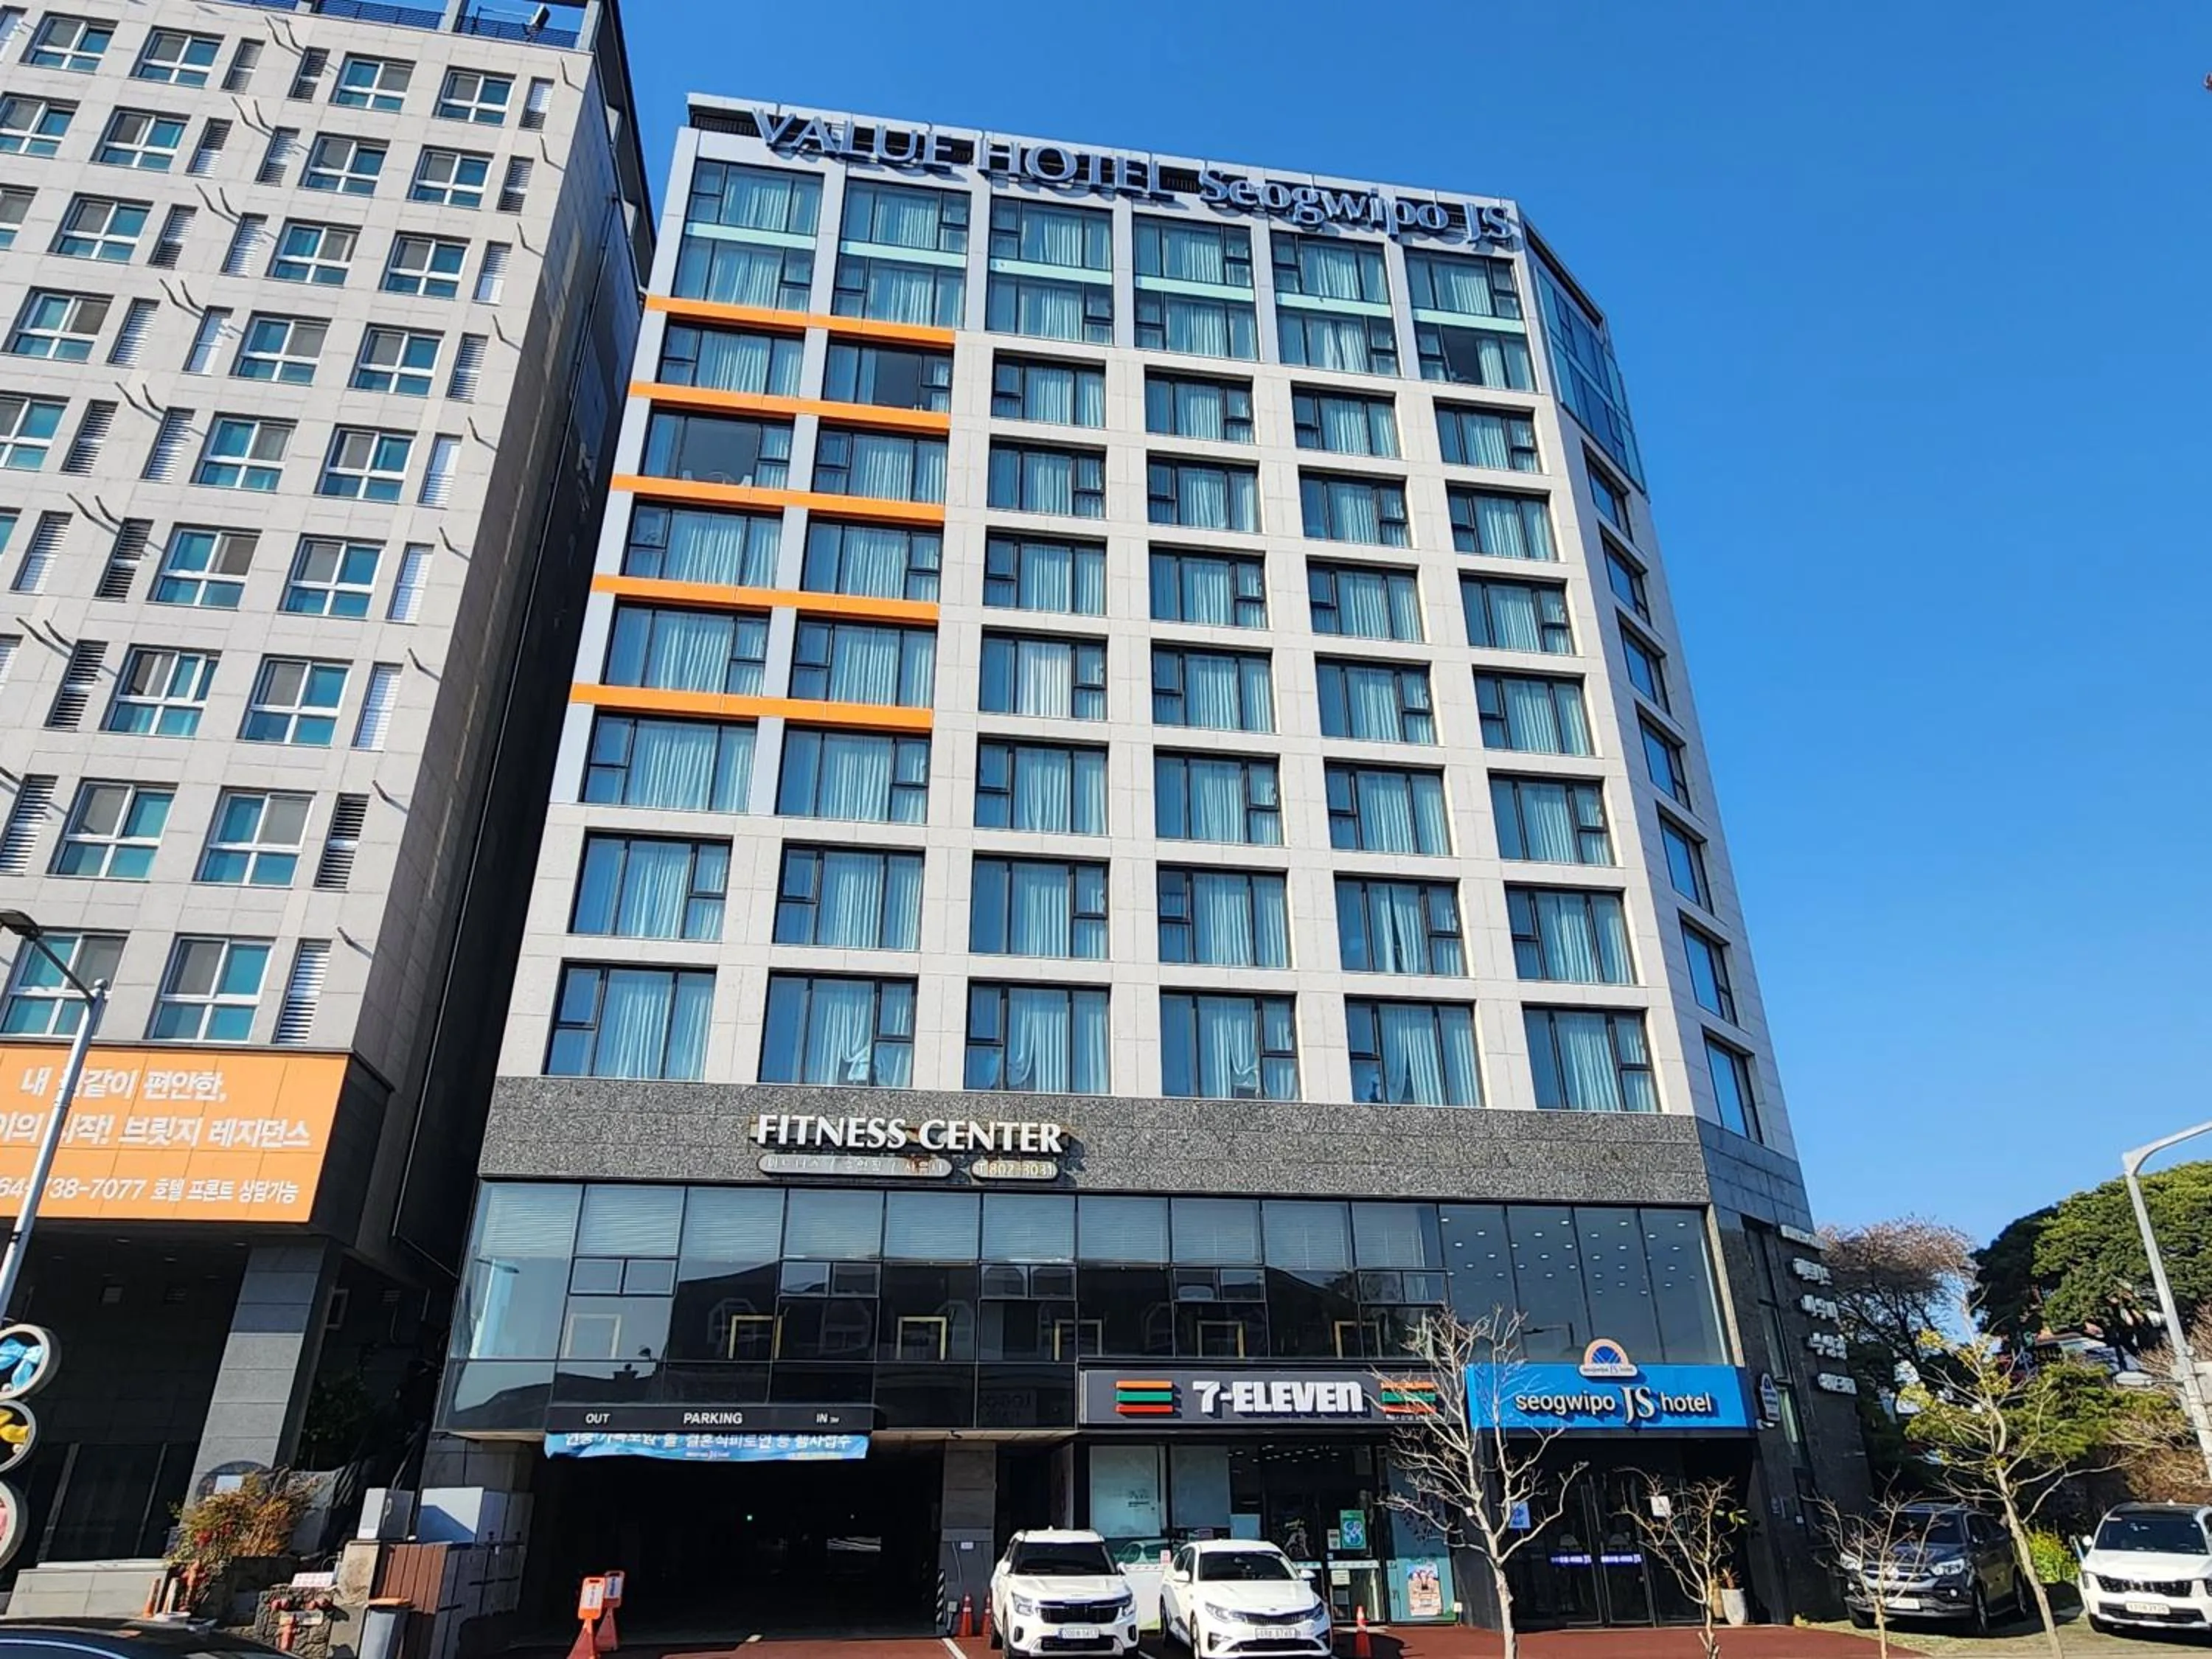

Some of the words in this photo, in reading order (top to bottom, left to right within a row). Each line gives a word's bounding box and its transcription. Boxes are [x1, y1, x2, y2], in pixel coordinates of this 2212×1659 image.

[752, 107, 953, 174] VALUE
[978, 137, 1175, 203] HOTEL
[1198, 167, 1450, 237] Seogwipo
[1466, 200, 1514, 243] JS
[21, 1066, 52, 1097] 내
[58, 1067, 140, 1099] 같이
[143, 1070, 228, 1103] 편안한,
[118, 1116, 203, 1147] 브릿지
[207, 1118, 312, 1149] 레지던스
[756, 1114, 908, 1150] FITNESS
[919, 1119, 1063, 1153] CENTER
[0, 1177, 147, 1201] 64-38-7077
[150, 1178, 185, 1202] 호텔
[187, 1179, 235, 1202] 프론트
[239, 1180, 299, 1204] 상담가능
[585, 1413, 611, 1424] OUT
[684, 1413, 743, 1425] PARKING
[816, 1413, 829, 1424] IN
[1515, 1391, 1615, 1416] seogwipo
[1622, 1386, 1655, 1424] JS
[1660, 1392, 1712, 1413] hotel
